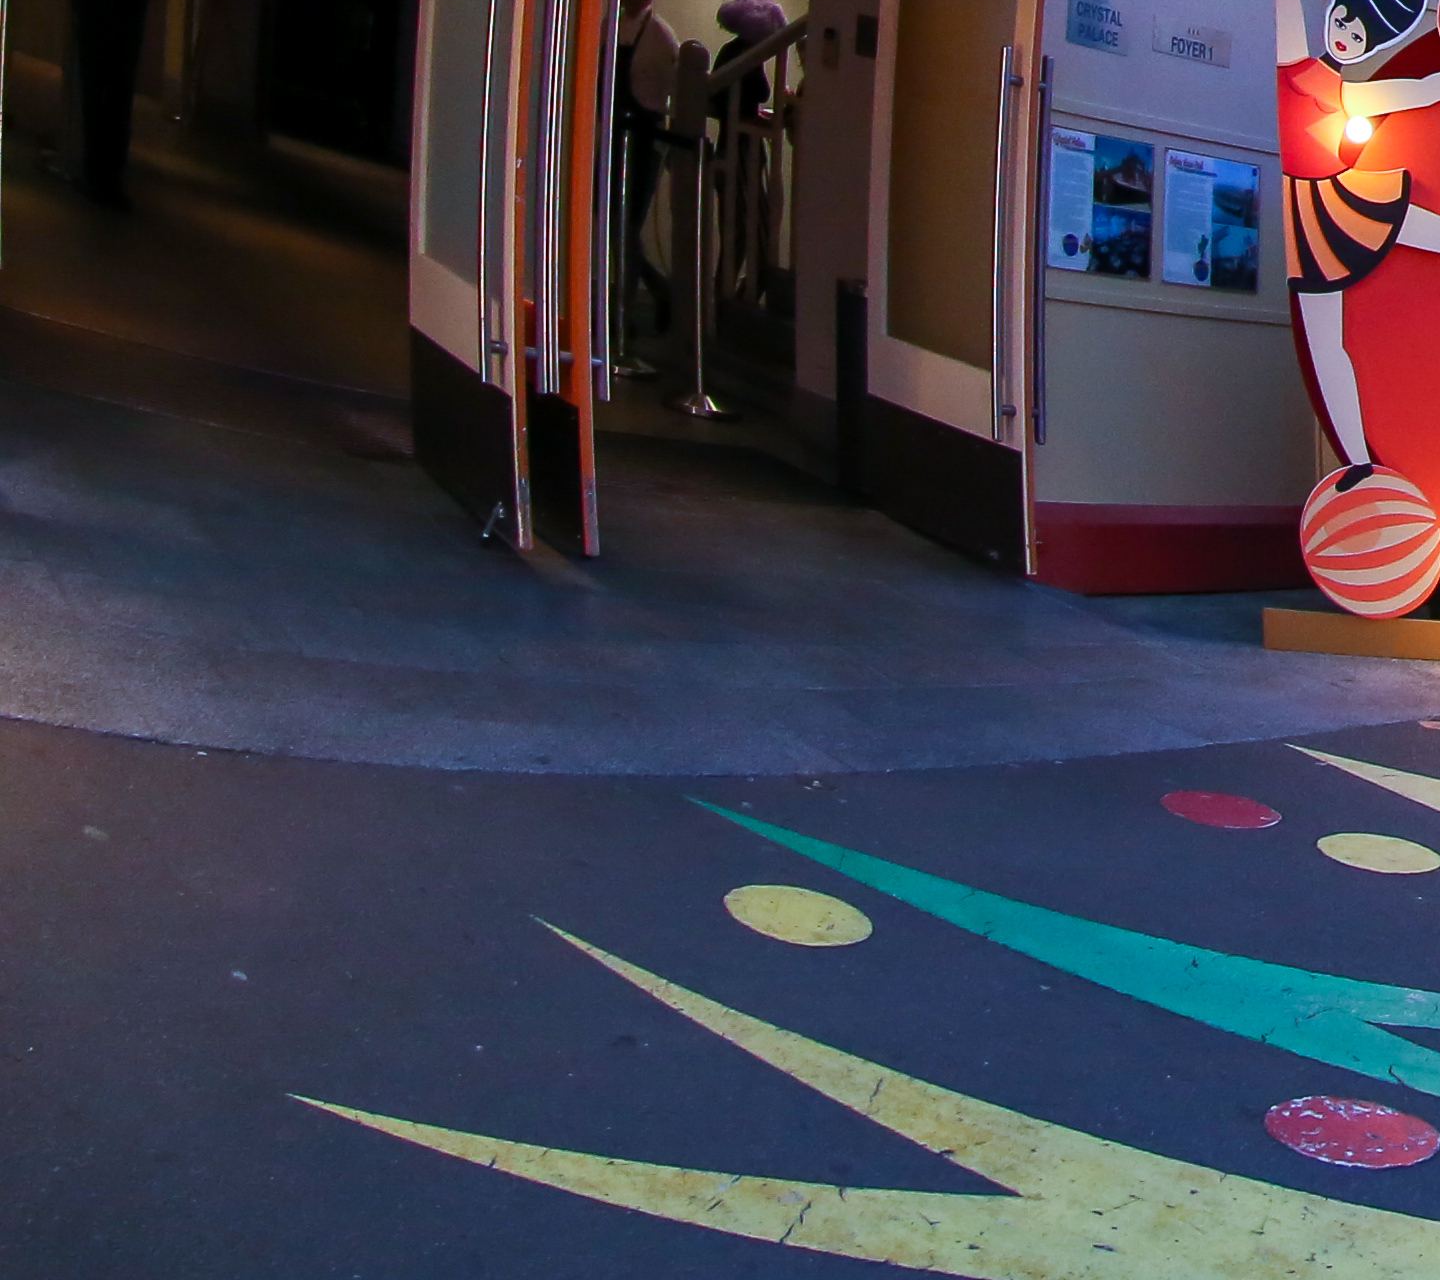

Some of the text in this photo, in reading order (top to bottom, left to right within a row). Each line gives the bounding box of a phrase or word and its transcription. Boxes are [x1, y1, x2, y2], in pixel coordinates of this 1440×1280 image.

[1076, 0, 1123, 27] CRYSTAL
[1079, 22, 1119, 48] PALACE
[1171, 36, 1214, 62] FOYER 1
